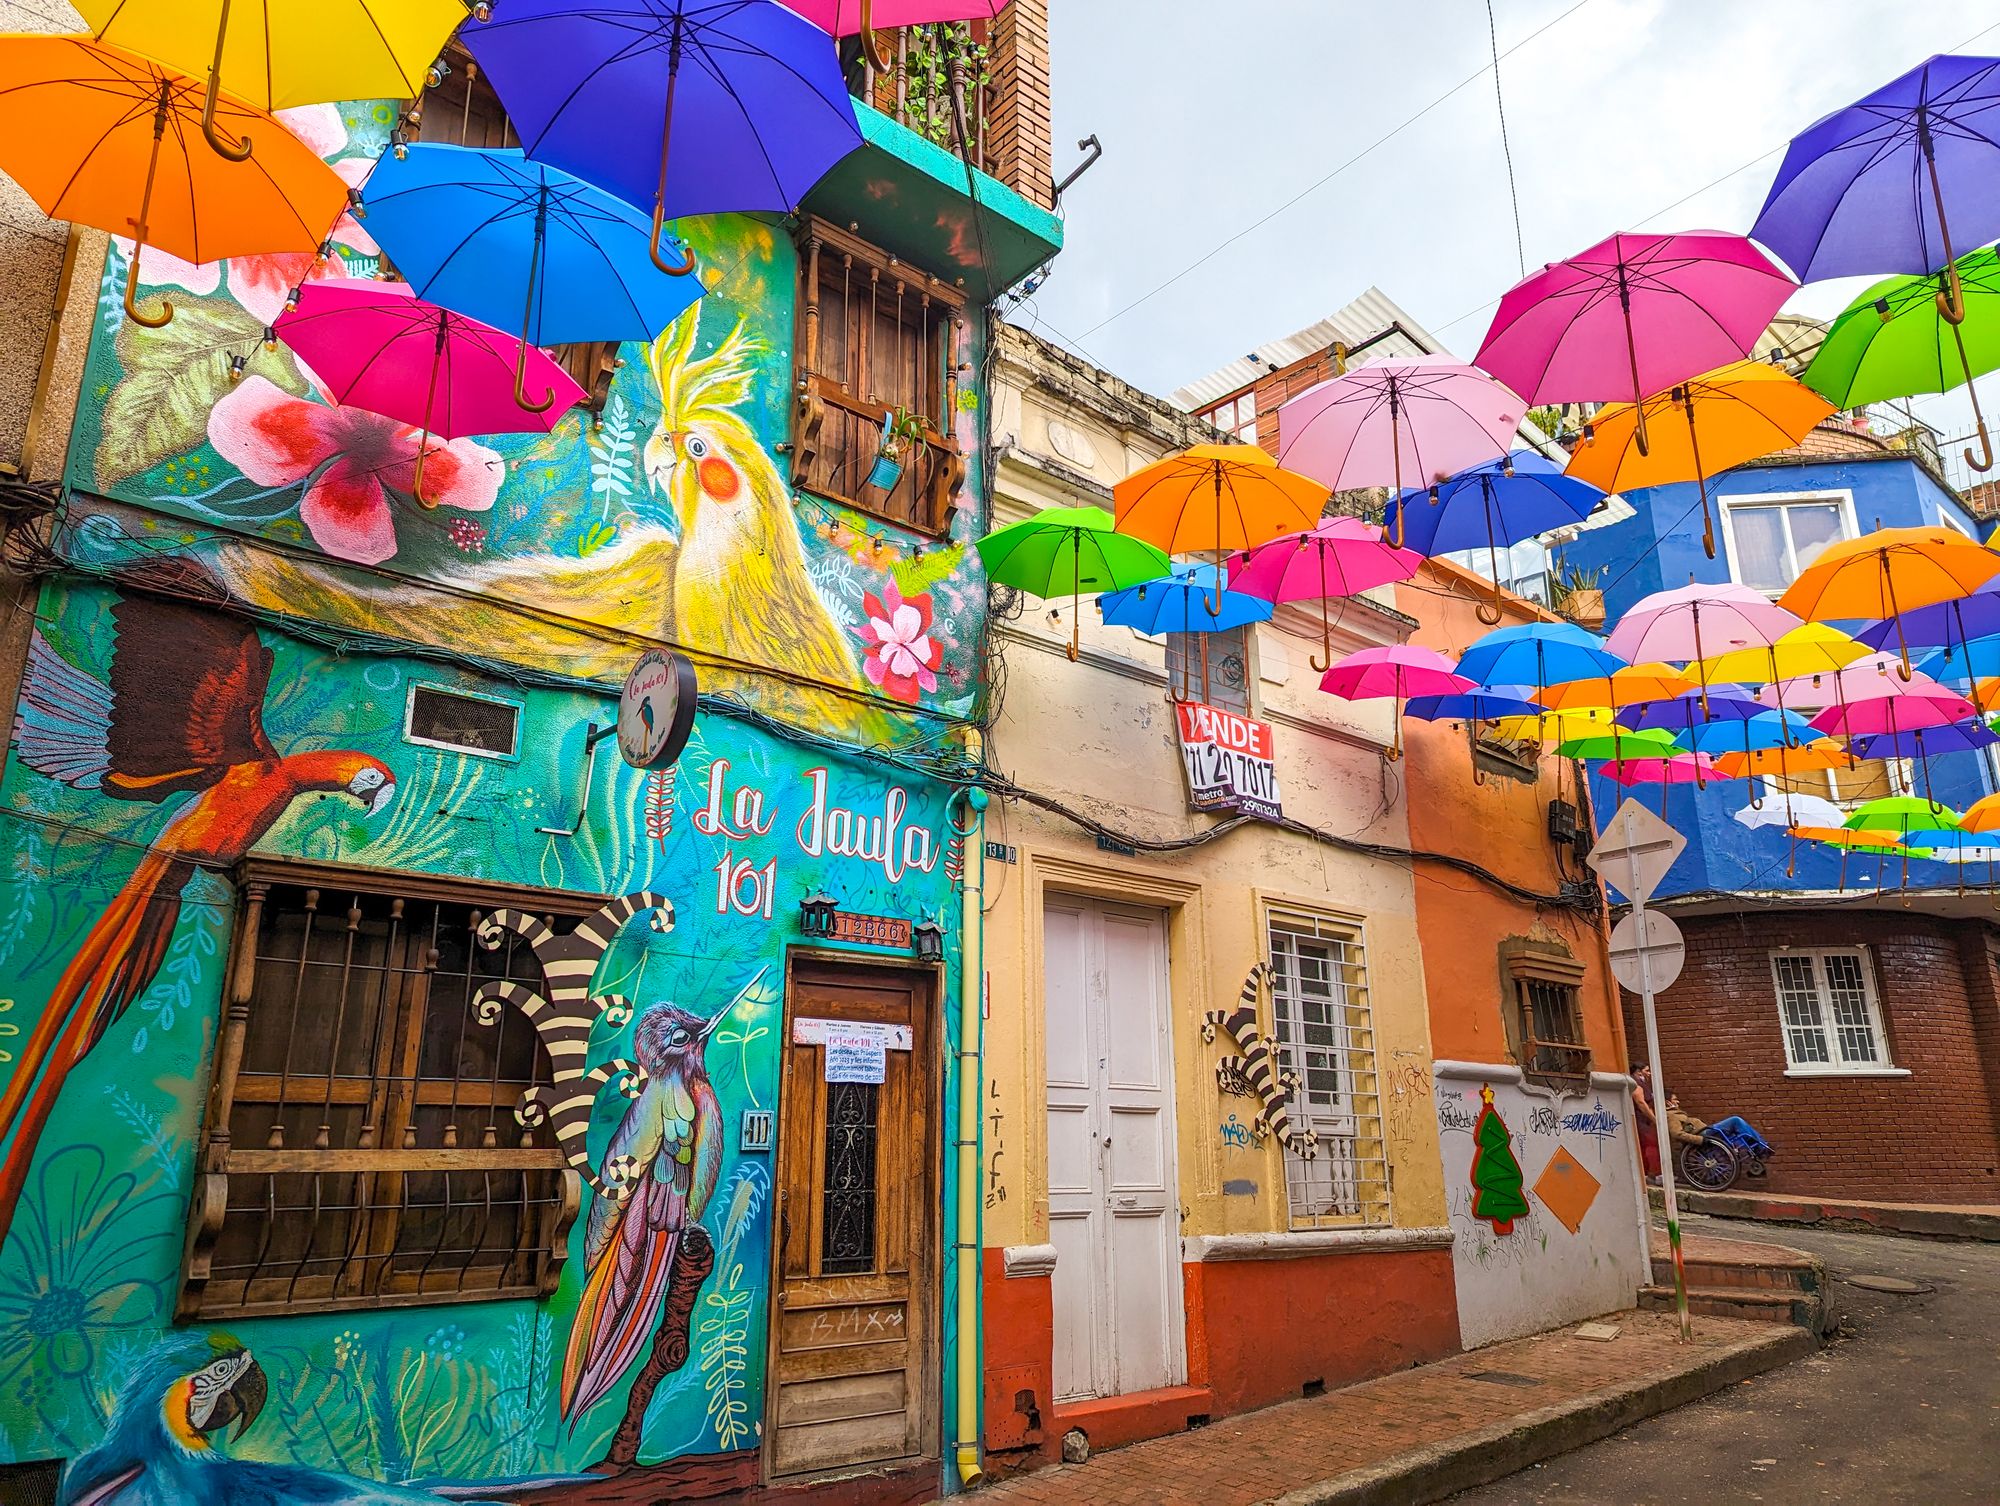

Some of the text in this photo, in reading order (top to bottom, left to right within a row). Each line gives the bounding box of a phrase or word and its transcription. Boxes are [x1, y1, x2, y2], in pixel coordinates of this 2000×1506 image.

[1186, 706, 1261, 754] VENDE
[1198, 789, 1223, 801] metro
[1236, 754, 1274, 800] 7017
[693, 757, 940, 884] La Jaula
[987, 843, 997, 857] 13
[713, 850, 777, 921] 101
